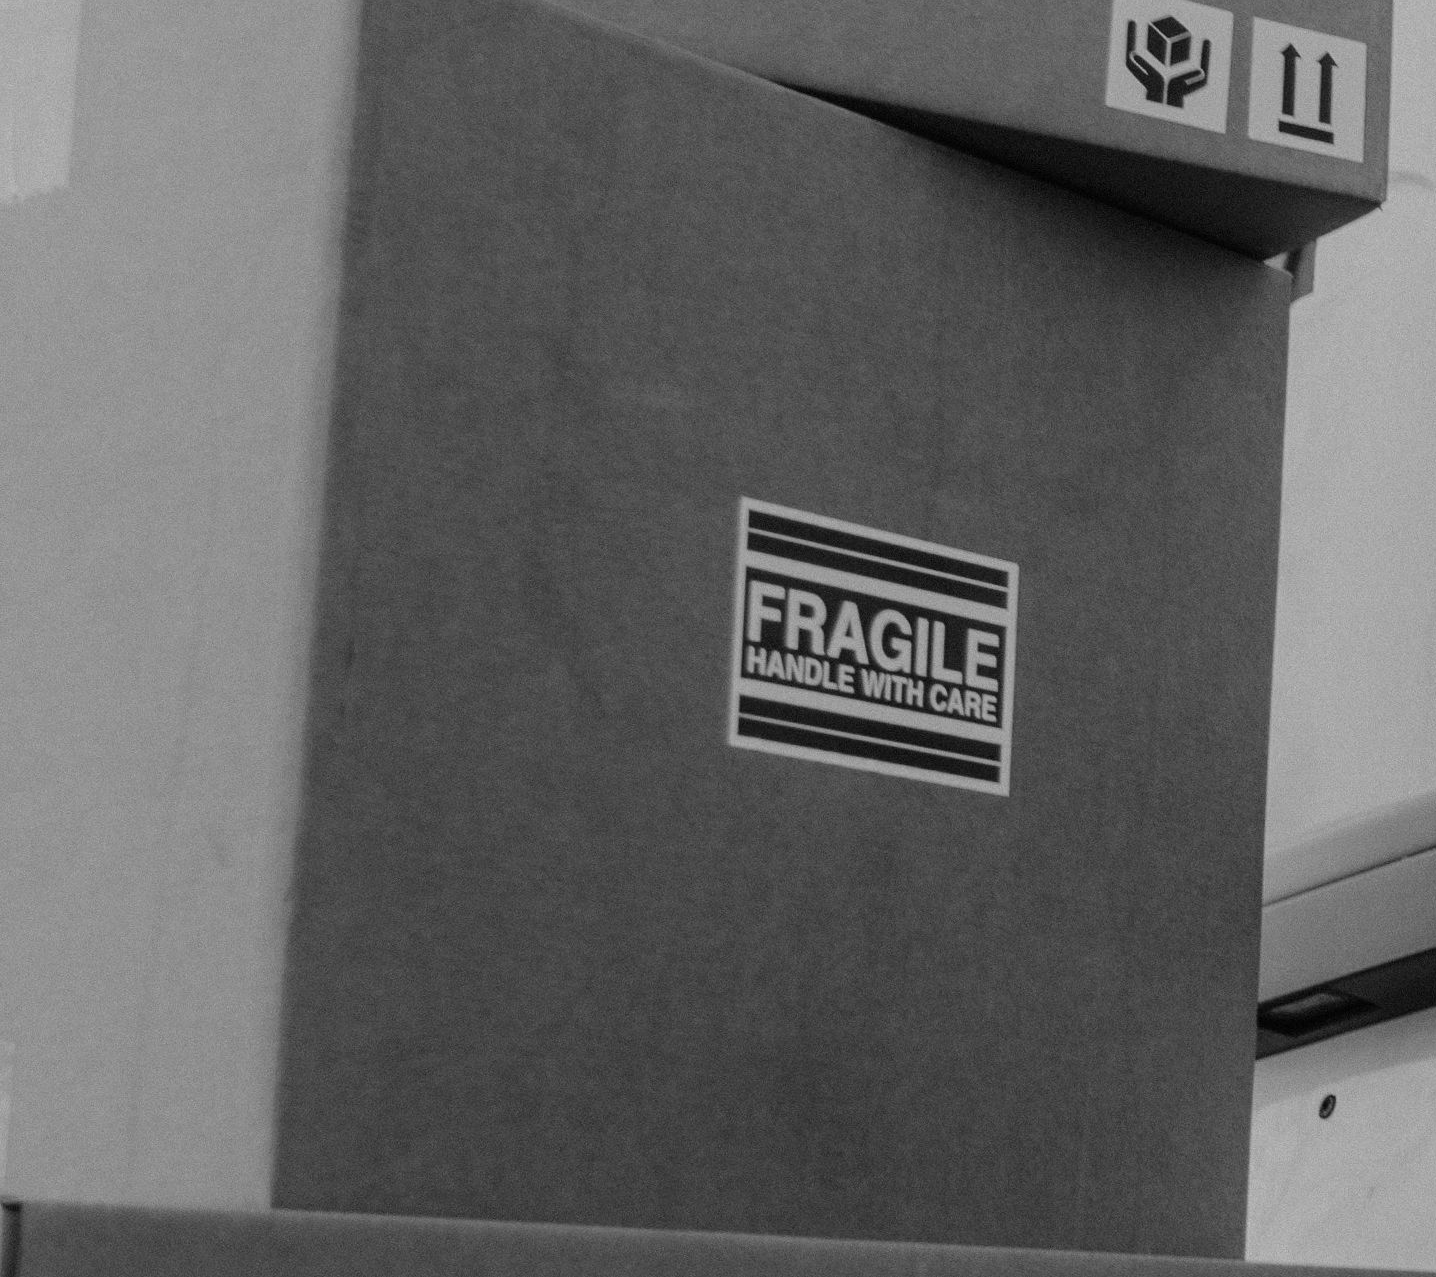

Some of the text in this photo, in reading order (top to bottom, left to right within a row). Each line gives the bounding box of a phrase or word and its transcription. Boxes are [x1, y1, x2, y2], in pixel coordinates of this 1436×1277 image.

[746, 645, 998, 723] HANDLE WITH CARE
[747, 579, 999, 693] FRAGILE
